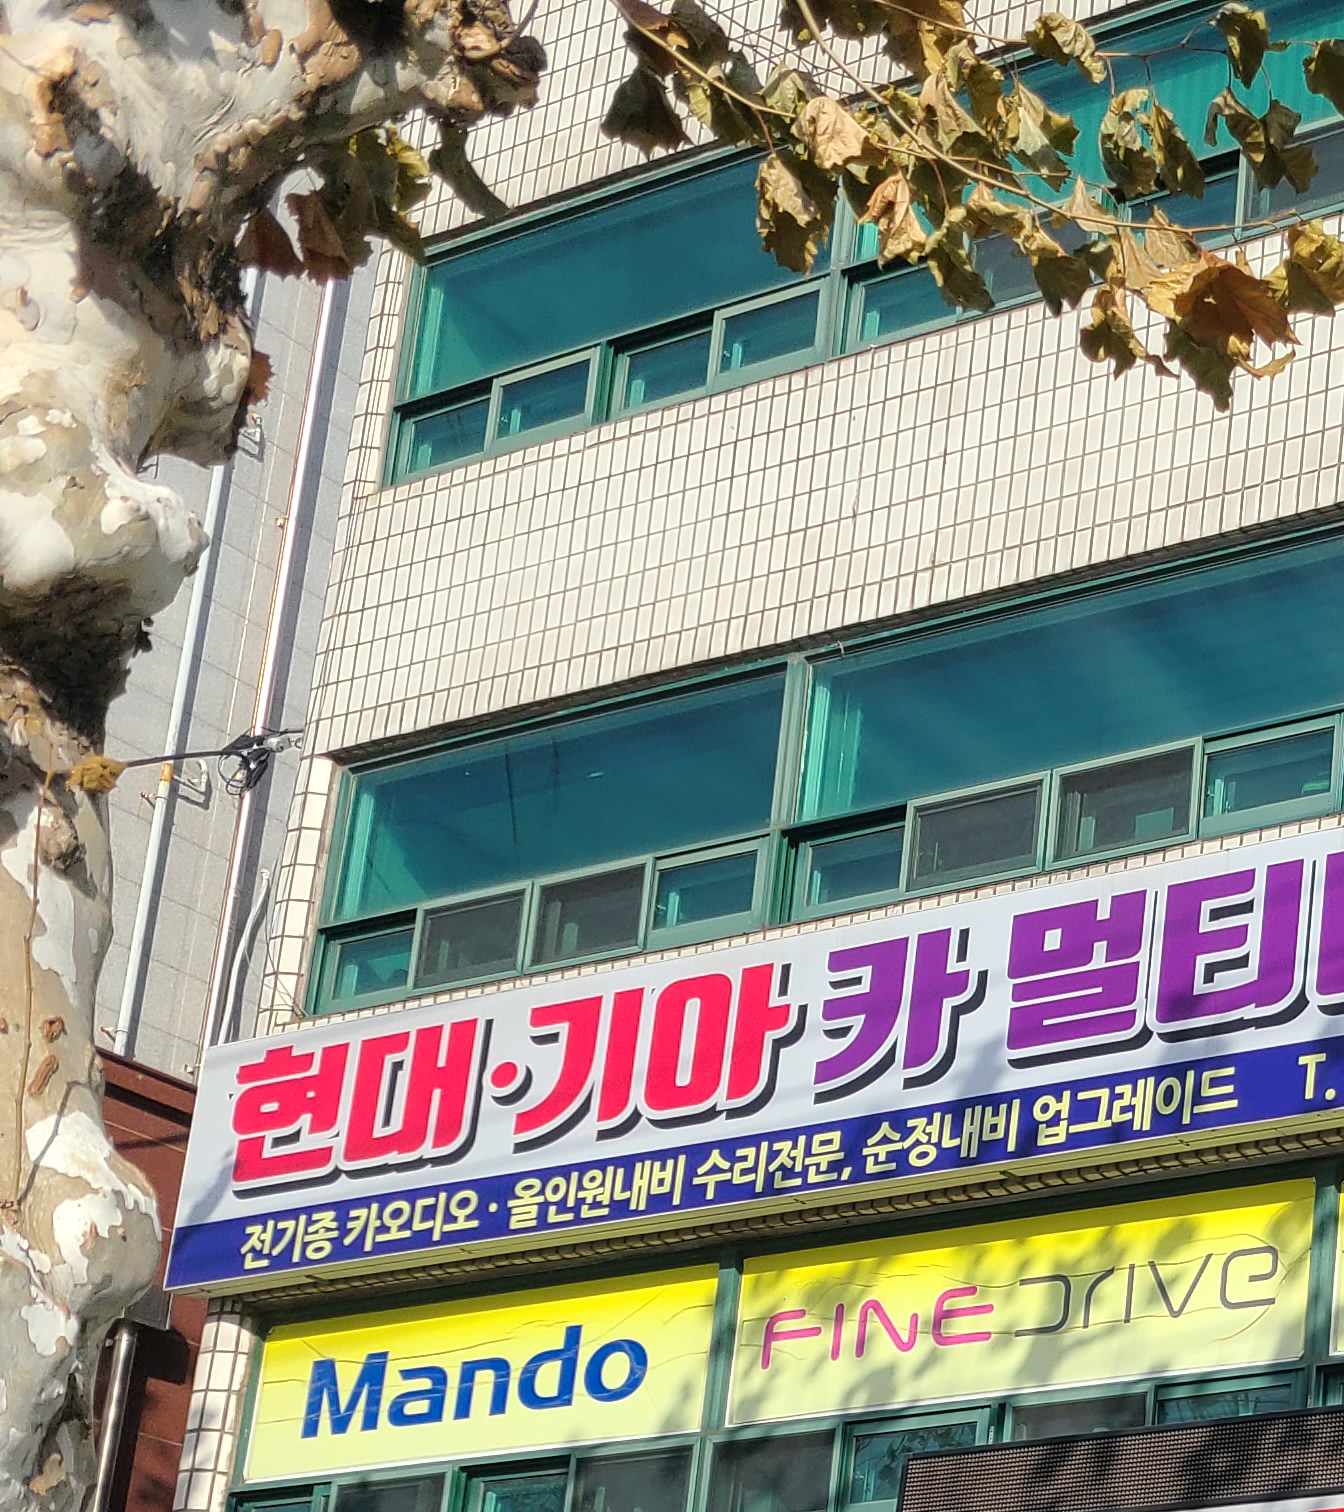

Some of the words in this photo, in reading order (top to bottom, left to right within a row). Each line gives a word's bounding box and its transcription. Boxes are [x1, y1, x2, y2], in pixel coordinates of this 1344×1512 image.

[814, 926, 986, 1102] 카
[1299, 1054, 1335, 1101] T.
[239, 1223, 334, 1270] 전기종
[343, 1190, 479, 1253] 카오디오
[507, 1156, 684, 1232] 올인원내비
[692, 1134, 852, 1205] 수리전문,
[864, 1108, 1017, 1175] 순정내비
[1032, 1066, 1238, 1148] 업그레이드
[301, 1323, 647, 1438] Mando
